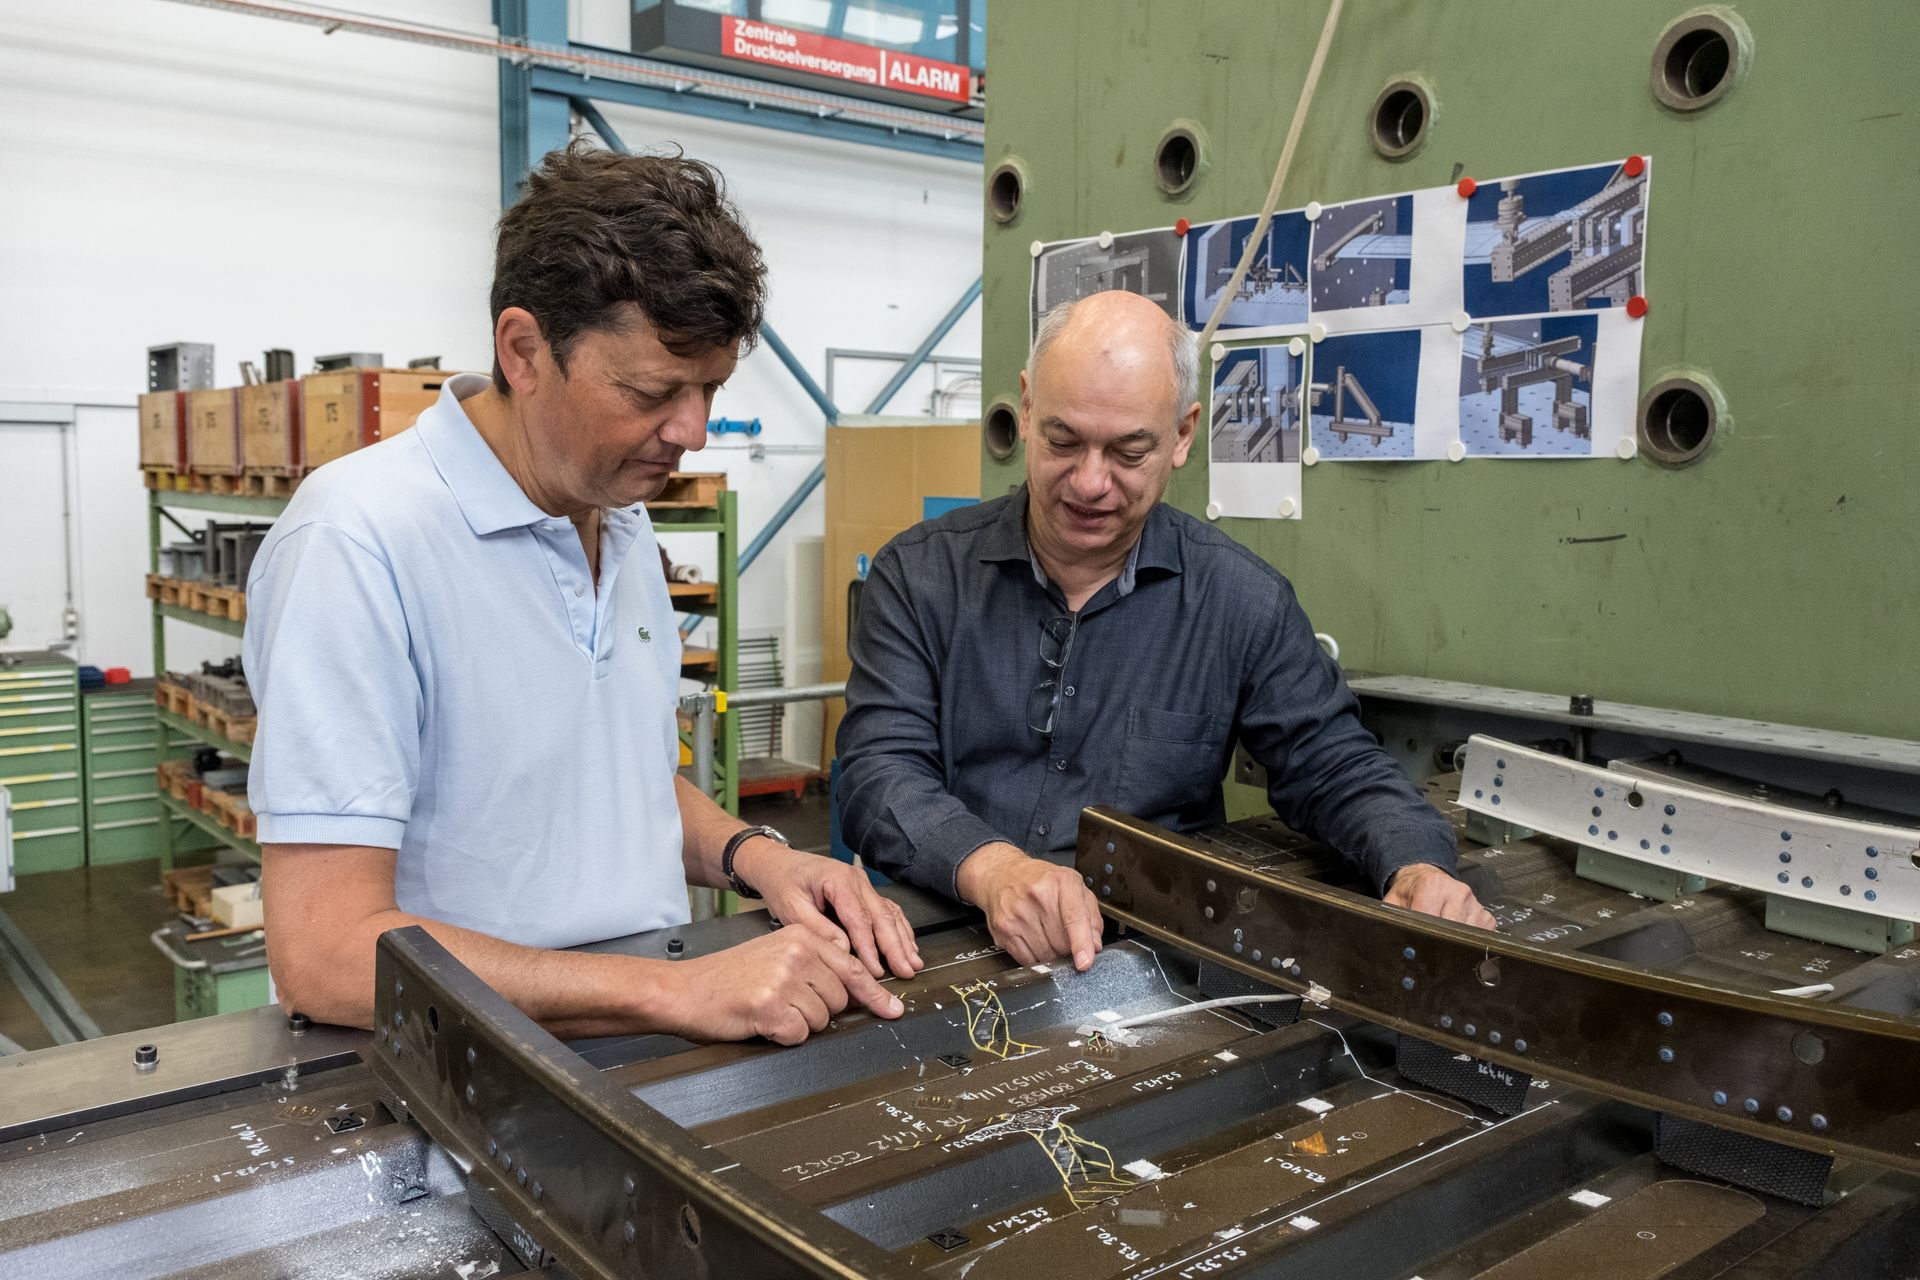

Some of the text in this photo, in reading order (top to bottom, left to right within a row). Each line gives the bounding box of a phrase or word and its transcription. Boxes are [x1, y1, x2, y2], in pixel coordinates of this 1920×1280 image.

[735, 19, 797, 47] Zentrale
[734, 37, 877, 83] Druckoelversorgung
[890, 61, 960, 94] ALARM
[1086, 1224, 1141, 1261] R3_30_1
[1179, 1246, 1247, 1279] S3_33_1
